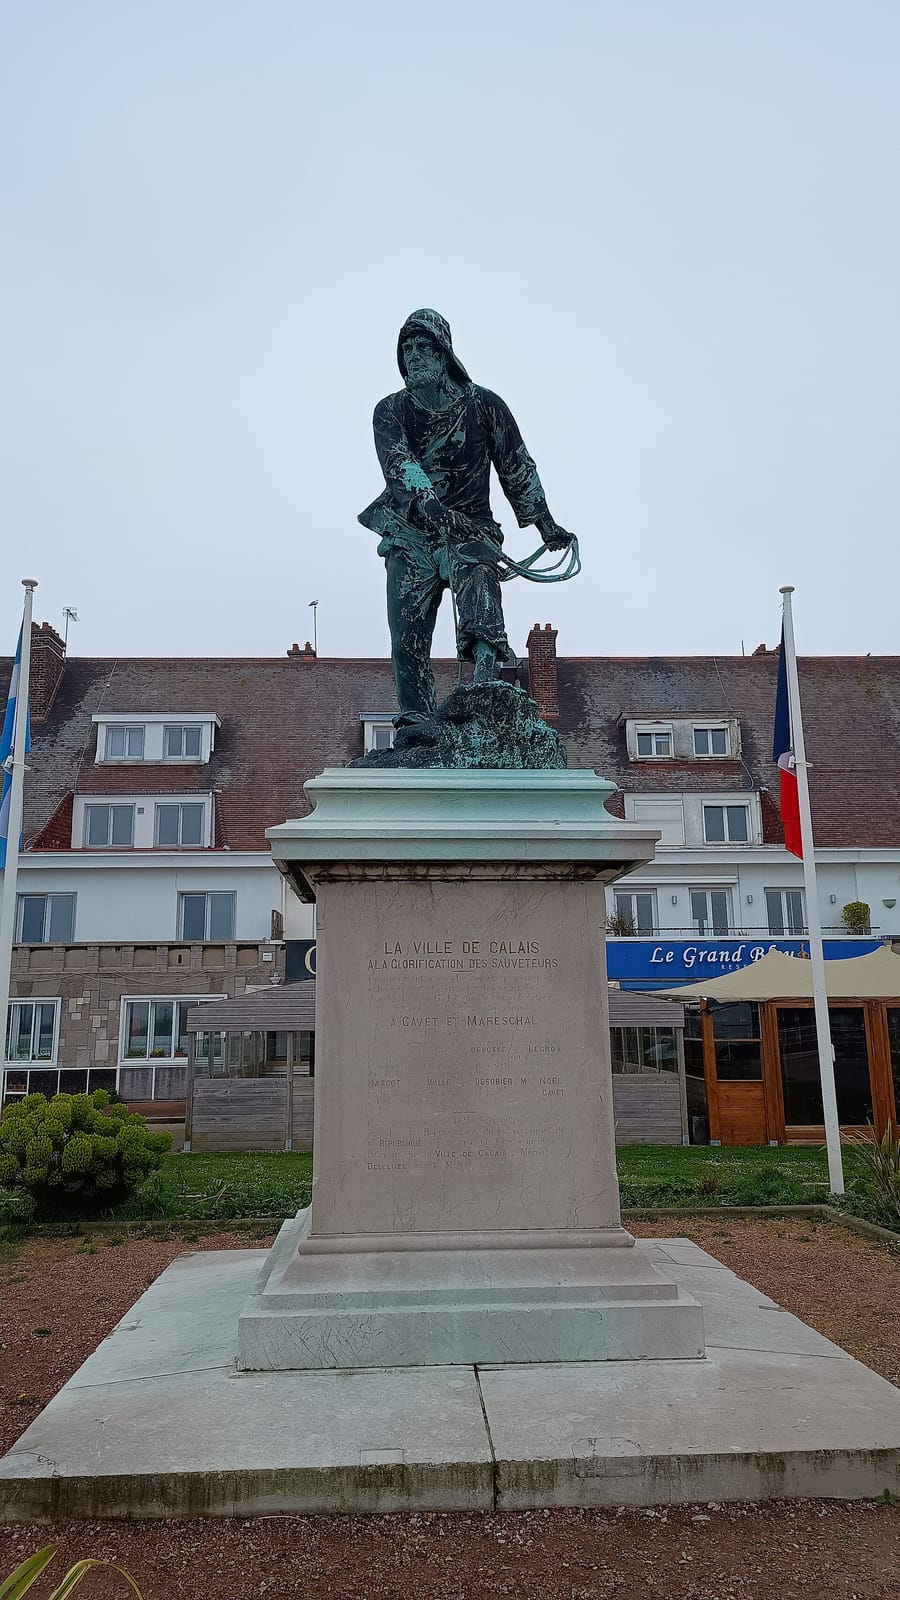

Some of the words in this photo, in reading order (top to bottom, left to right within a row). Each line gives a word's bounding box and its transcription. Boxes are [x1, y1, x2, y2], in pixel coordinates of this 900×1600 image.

[384, 941, 402, 955] LA
[413, 941, 453, 954] VILLE
[462, 941, 480, 954] DE
[489, 941, 540, 954] CALAIS
[650, 947, 674, 963] Le
[683, 944, 746, 968] Grand
[469, 959, 488, 969] DES
[491, 958, 559, 969] SAUVETEURS
[467, 1015, 537, 1026] MARESCHAL
